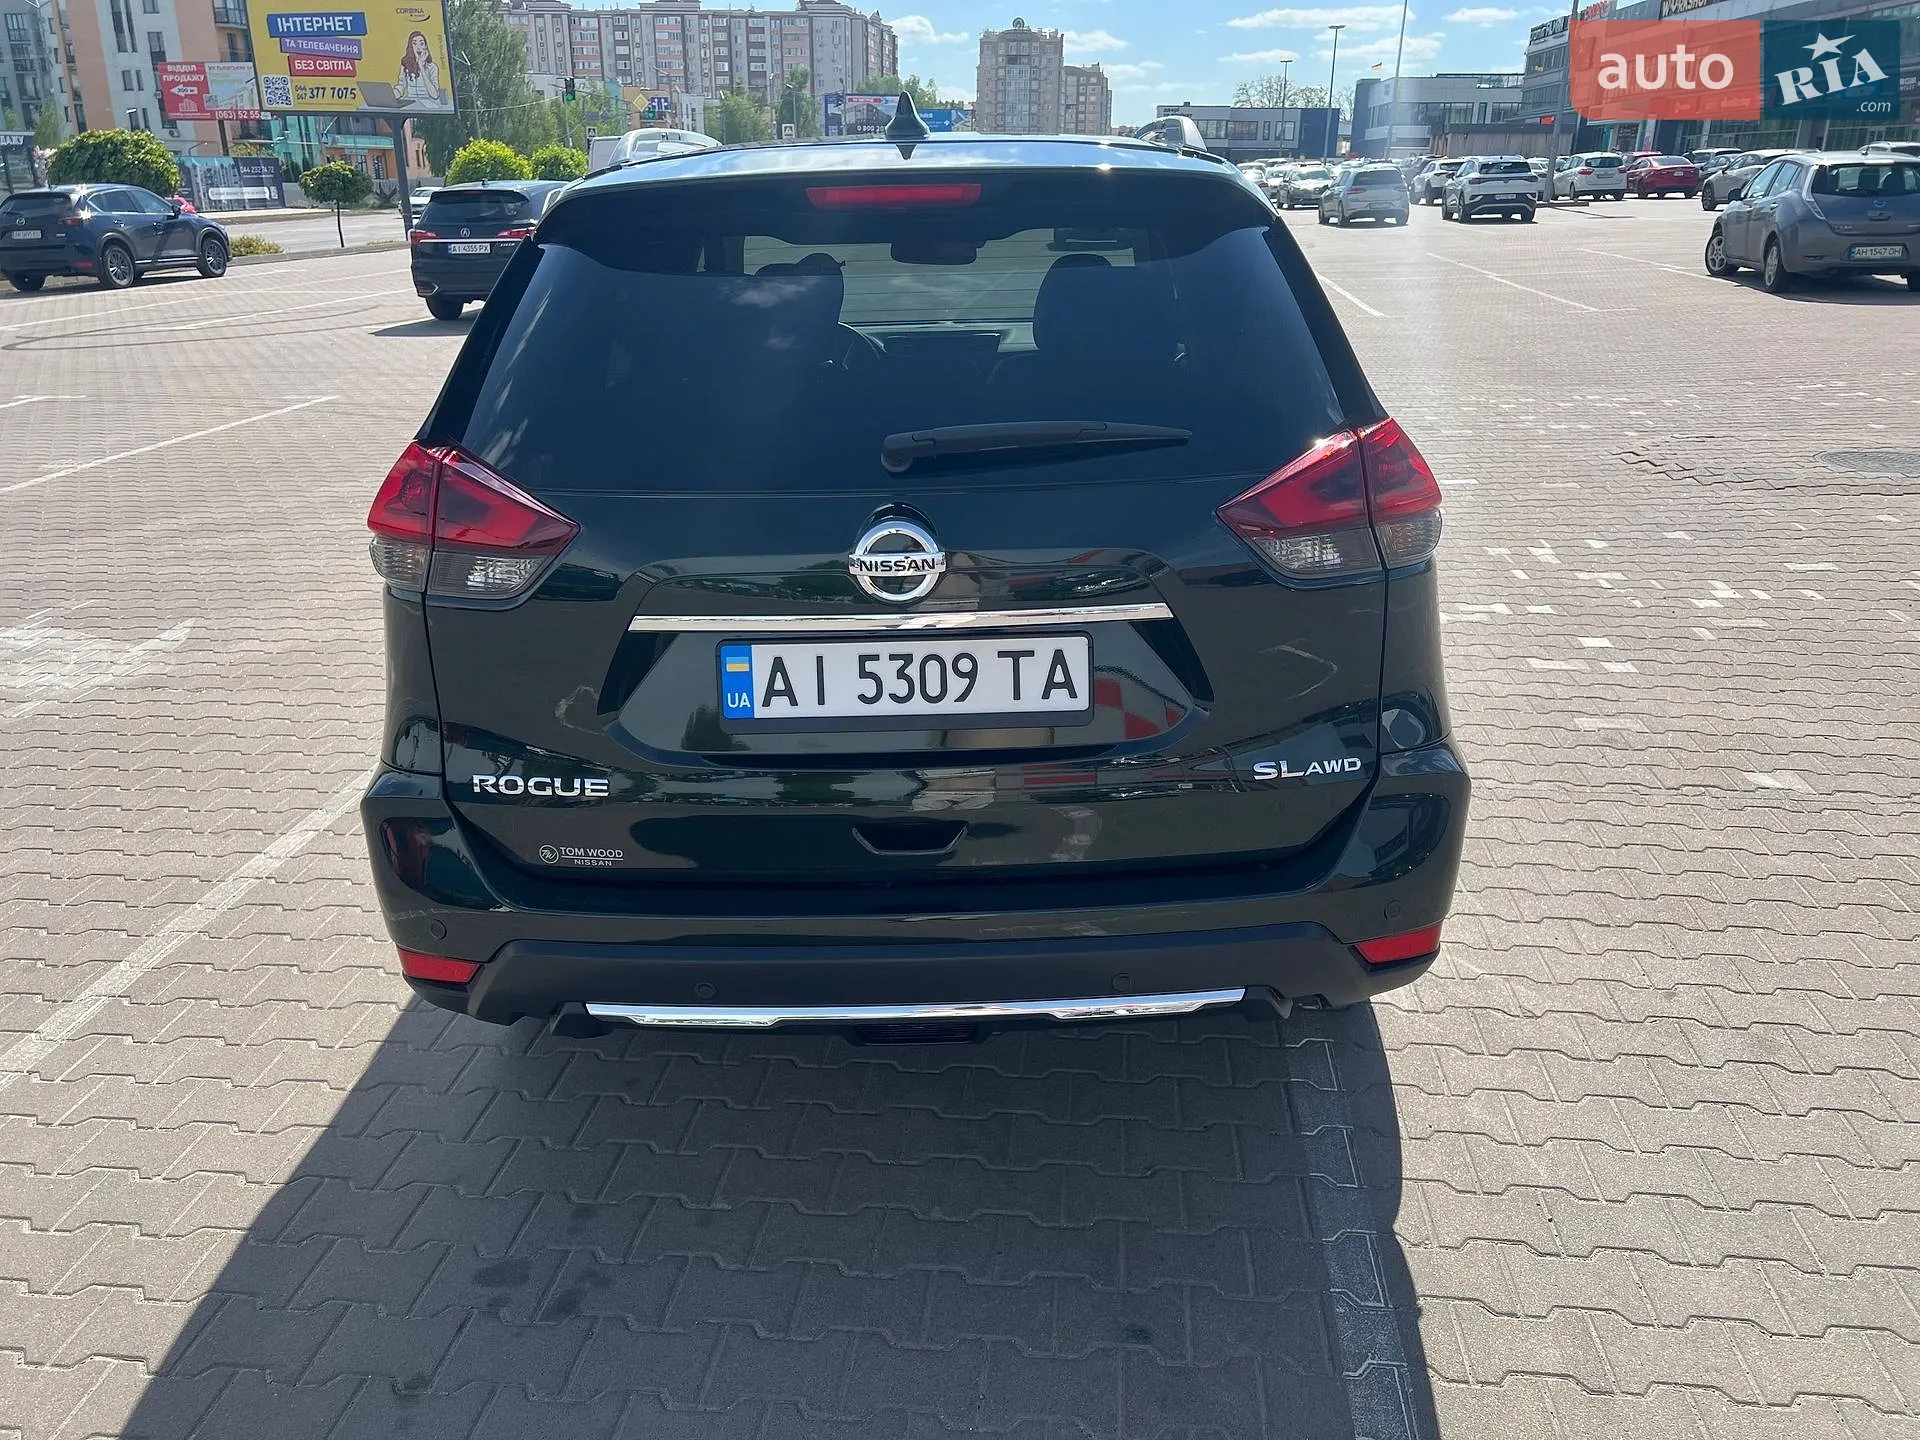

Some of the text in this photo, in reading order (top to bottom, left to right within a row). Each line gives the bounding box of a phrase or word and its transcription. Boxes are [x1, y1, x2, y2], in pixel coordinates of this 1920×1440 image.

[277, 16, 352, 32] ІНТЕРНЕТ
[285, 39, 359, 54] ТА ТЕЛЕБАЧЕННЯ
[167, 64, 197, 72] ВІДДІЛ
[295, 60, 353, 71] БЕЗ СВІТЛА
[162, 74, 204, 82] ПРОДАЖУ
[308, 87, 356, 99] 377 7075
[215, 110, 237, 119] (063)
[238, 110, 248, 118] 52
[1856, 248, 1867, 257] AH
[1869, 247, 1887, 256] 1547
[858, 556, 937, 573] NISSAN
[761, 648, 1078, 707] AI 5309 TA
[727, 692, 751, 708] UA
[1252, 757, 1361, 780] SL AWD
[472, 774, 609, 797] ROGUE
[560, 847, 623, 858] TOM WOOD
[574, 859, 612, 867] NISSAN
